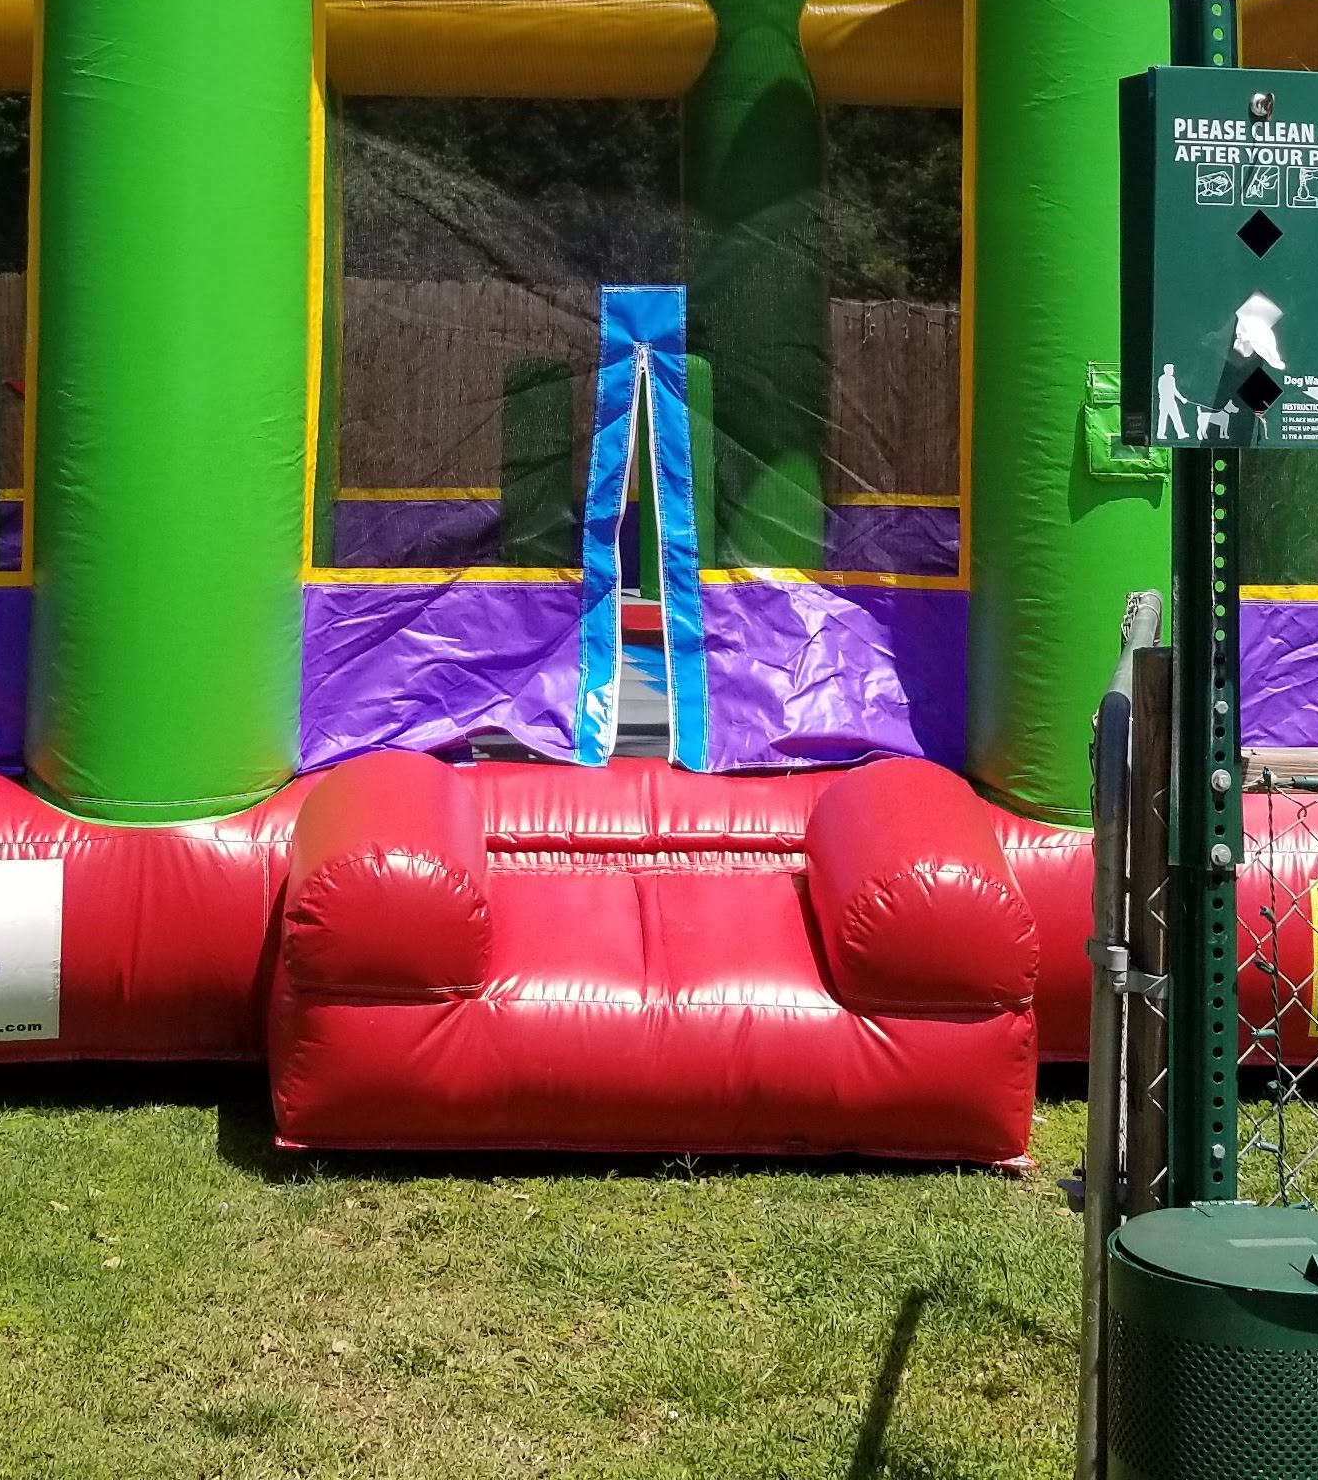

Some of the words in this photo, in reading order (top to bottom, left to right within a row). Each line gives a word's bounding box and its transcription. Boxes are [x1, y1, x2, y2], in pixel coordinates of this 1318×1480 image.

[1174, 118, 1247, 141] PLEASE
[1251, 121, 1315, 143] CLEAN
[1174, 145, 1241, 163] AFTER
[1245, 148, 1303, 165] YOUR
[1284, 375, 1303, 387] Dog
